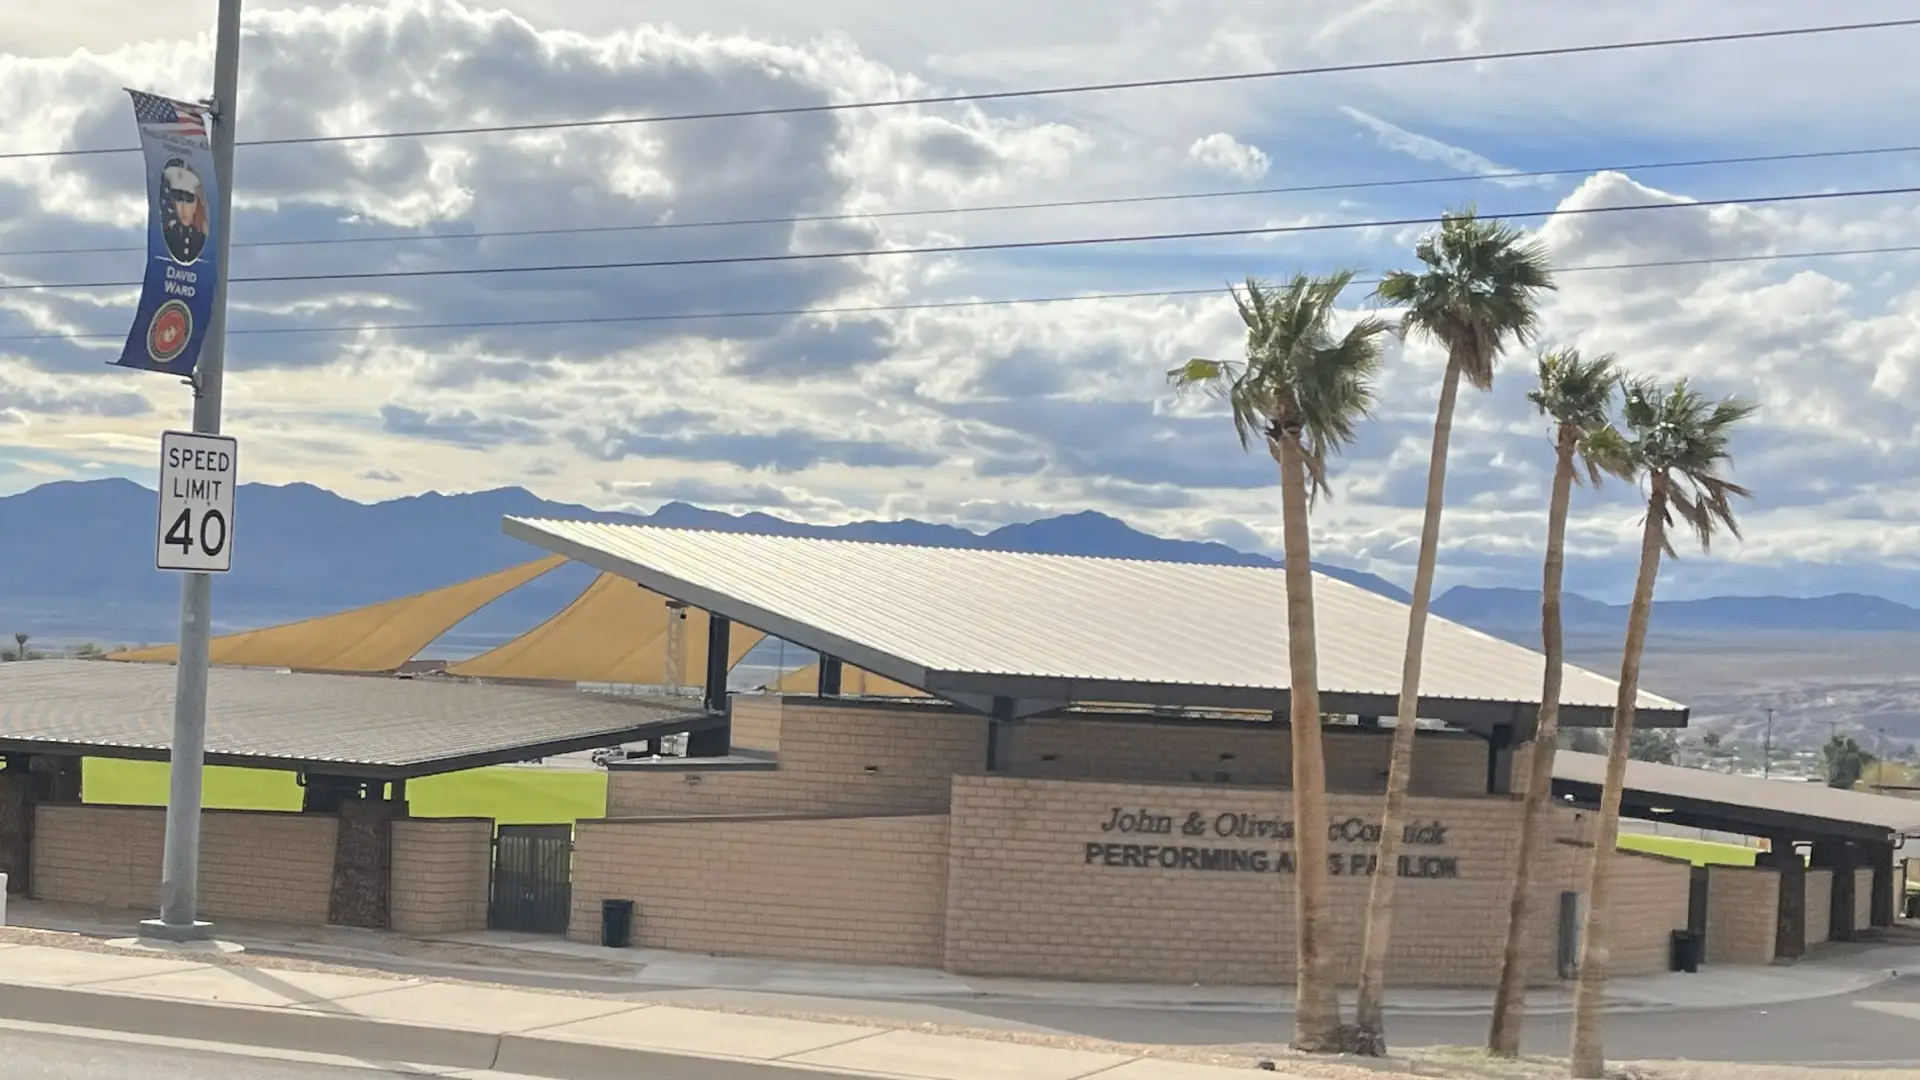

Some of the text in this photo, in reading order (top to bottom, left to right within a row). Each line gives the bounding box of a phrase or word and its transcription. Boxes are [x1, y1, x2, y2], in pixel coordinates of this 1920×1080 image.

[165, 266, 198, 283] DAVID
[164, 281, 196, 297] WARD
[168, 447, 230, 472] SPEED
[173, 477, 222, 501] LIMIT
[164, 507, 227, 557] 40
[1101, 807, 1172, 834] John
[1182, 810, 1206, 836] &
[1215, 813, 1294, 838] Olivia
[1085, 842, 1458, 878] PERFORMING AS PAILION
